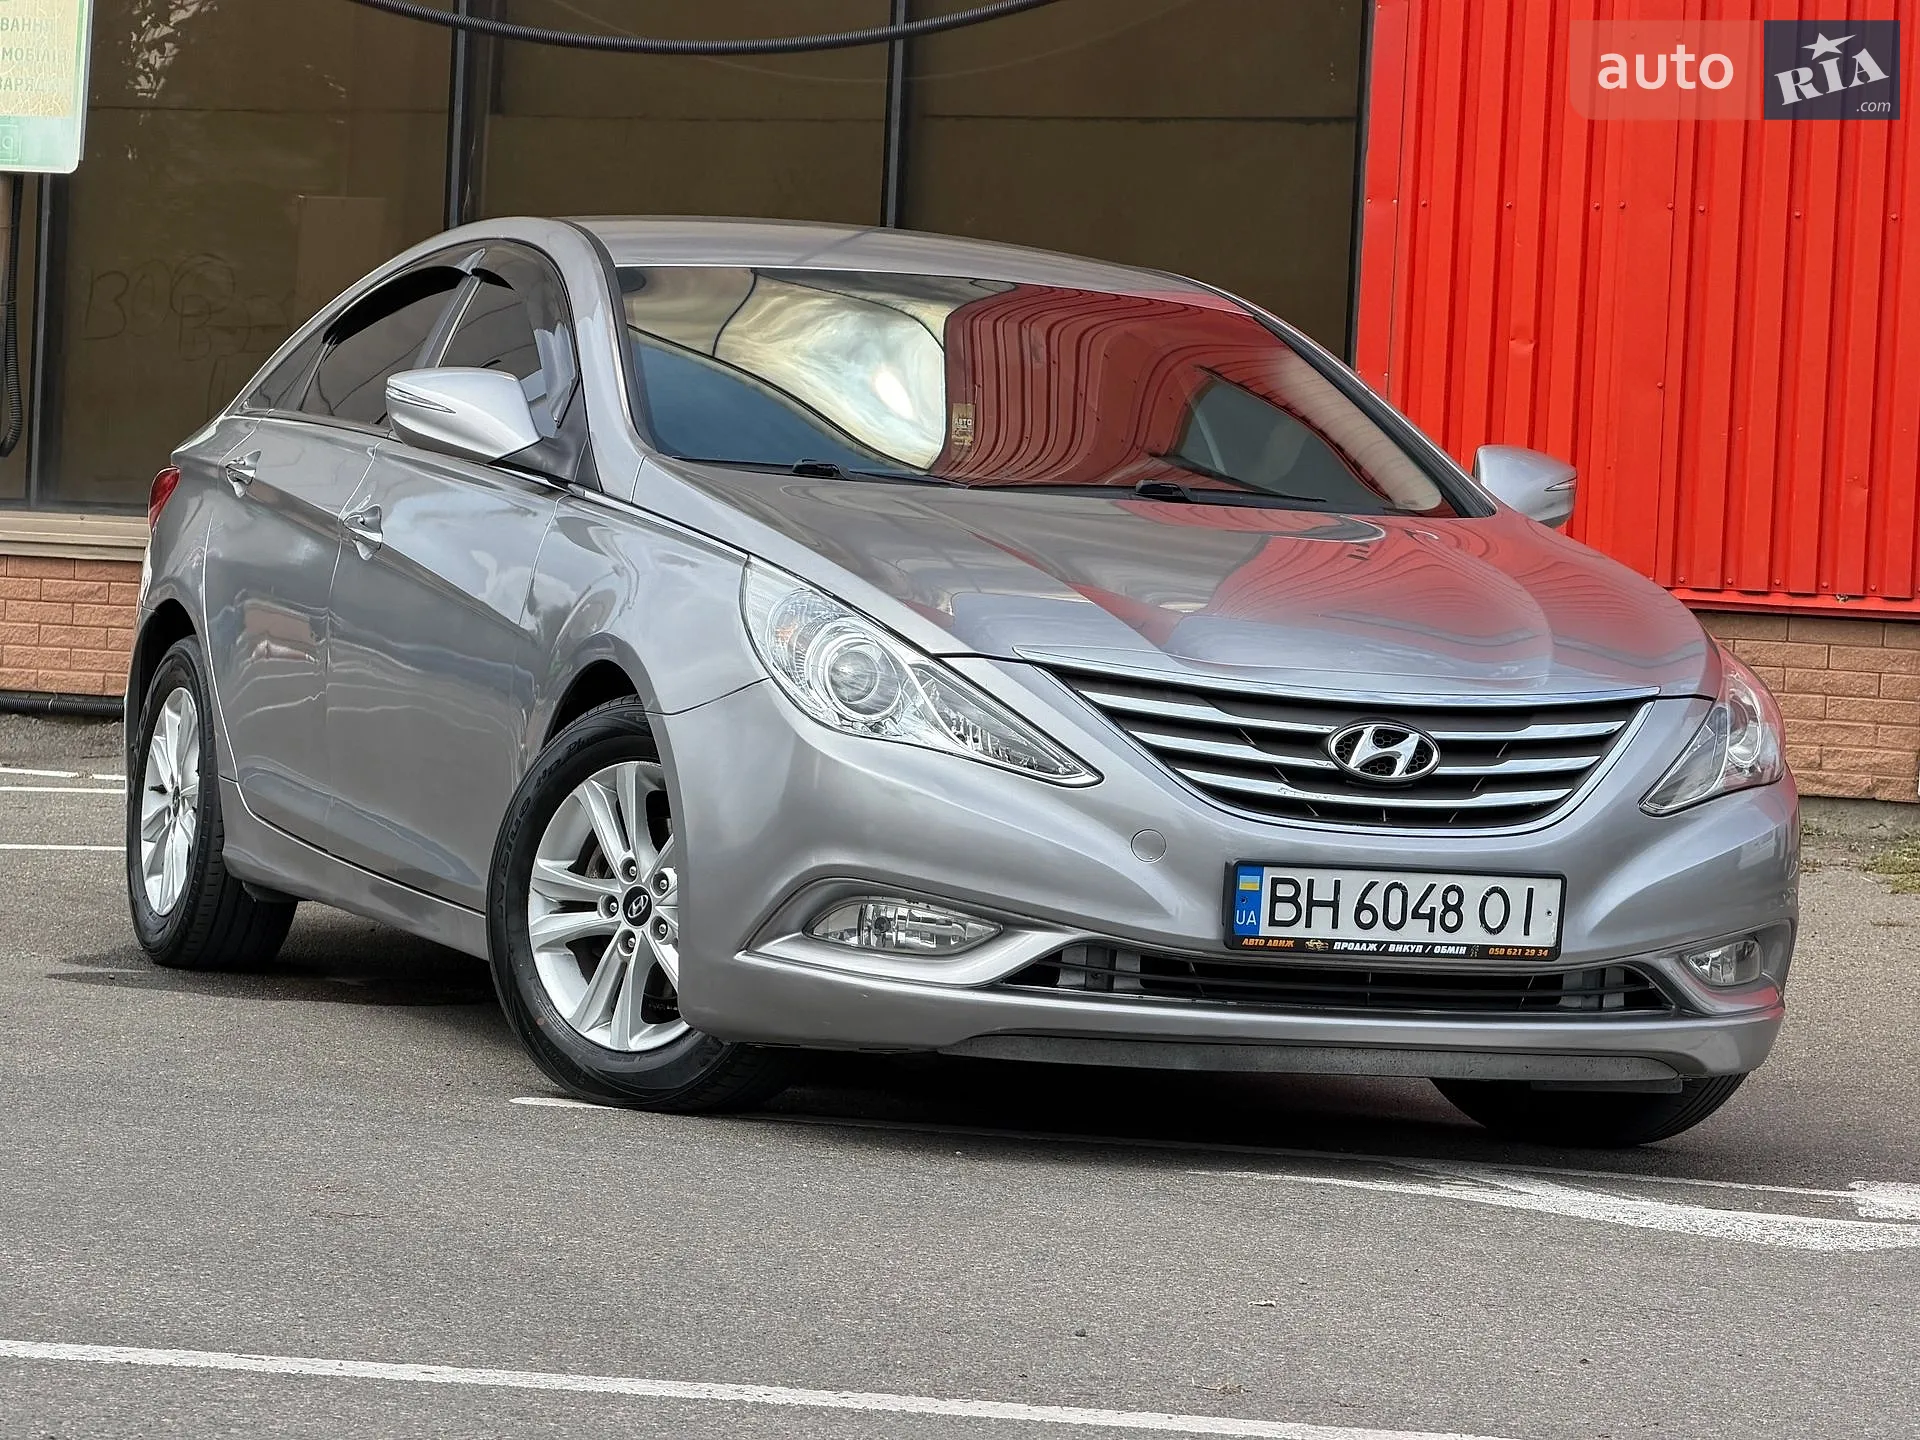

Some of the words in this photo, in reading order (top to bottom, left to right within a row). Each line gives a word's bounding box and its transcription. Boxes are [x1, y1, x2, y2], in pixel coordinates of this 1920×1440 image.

[1267, 876, 1341, 929] BH
[1353, 880, 1465, 934] 6048
[1236, 909, 1257, 927] UA
[1241, 937, 1265, 946] АВТО
[1266, 939, 1295, 948] ДВИЖ
[1333, 941, 1379, 951] ПРОДАЖ
[1388, 944, 1423, 953] ВИКУП
[1433, 945, 1467, 955] ОБМІН
[1488, 947, 1505, 955] 050
[1506, 948, 1522, 956] 621
[1524, 948, 1535, 957] 29
[1536, 949, 1549, 957] 34
